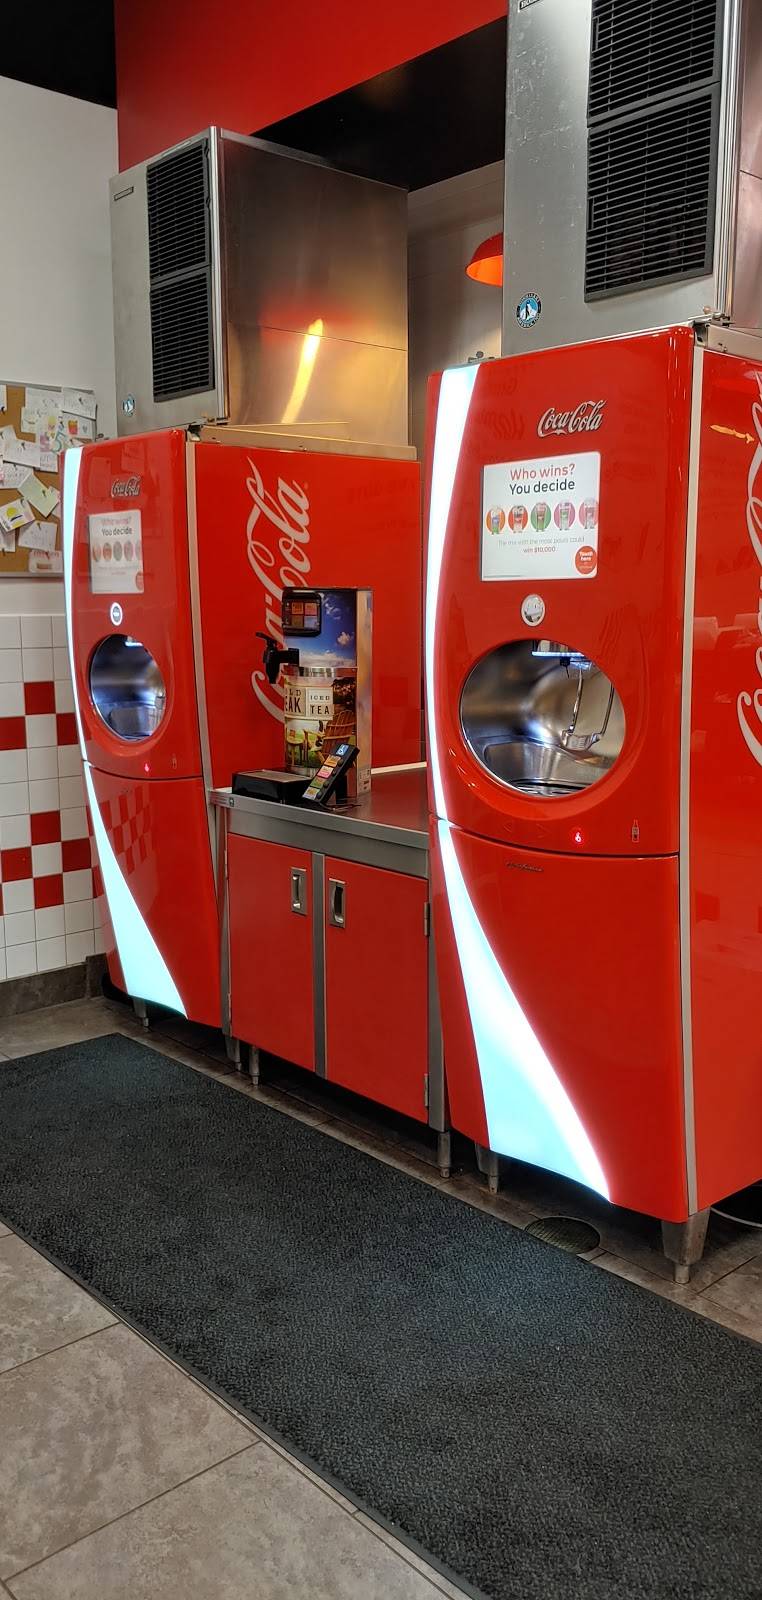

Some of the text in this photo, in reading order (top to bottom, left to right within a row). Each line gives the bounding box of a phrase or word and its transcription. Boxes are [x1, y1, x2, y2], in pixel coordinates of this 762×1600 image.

[538, 400, 606, 437] Coca-Cola
[510, 463, 576, 481] Who wins?
[111, 475, 141, 498] Coca-Cola
[509, 478, 575, 496] You decide
[101, 526, 132, 536] You decide
[246, 455, 311, 723] Ca-Cola
[310, 705, 330, 715] TEA
